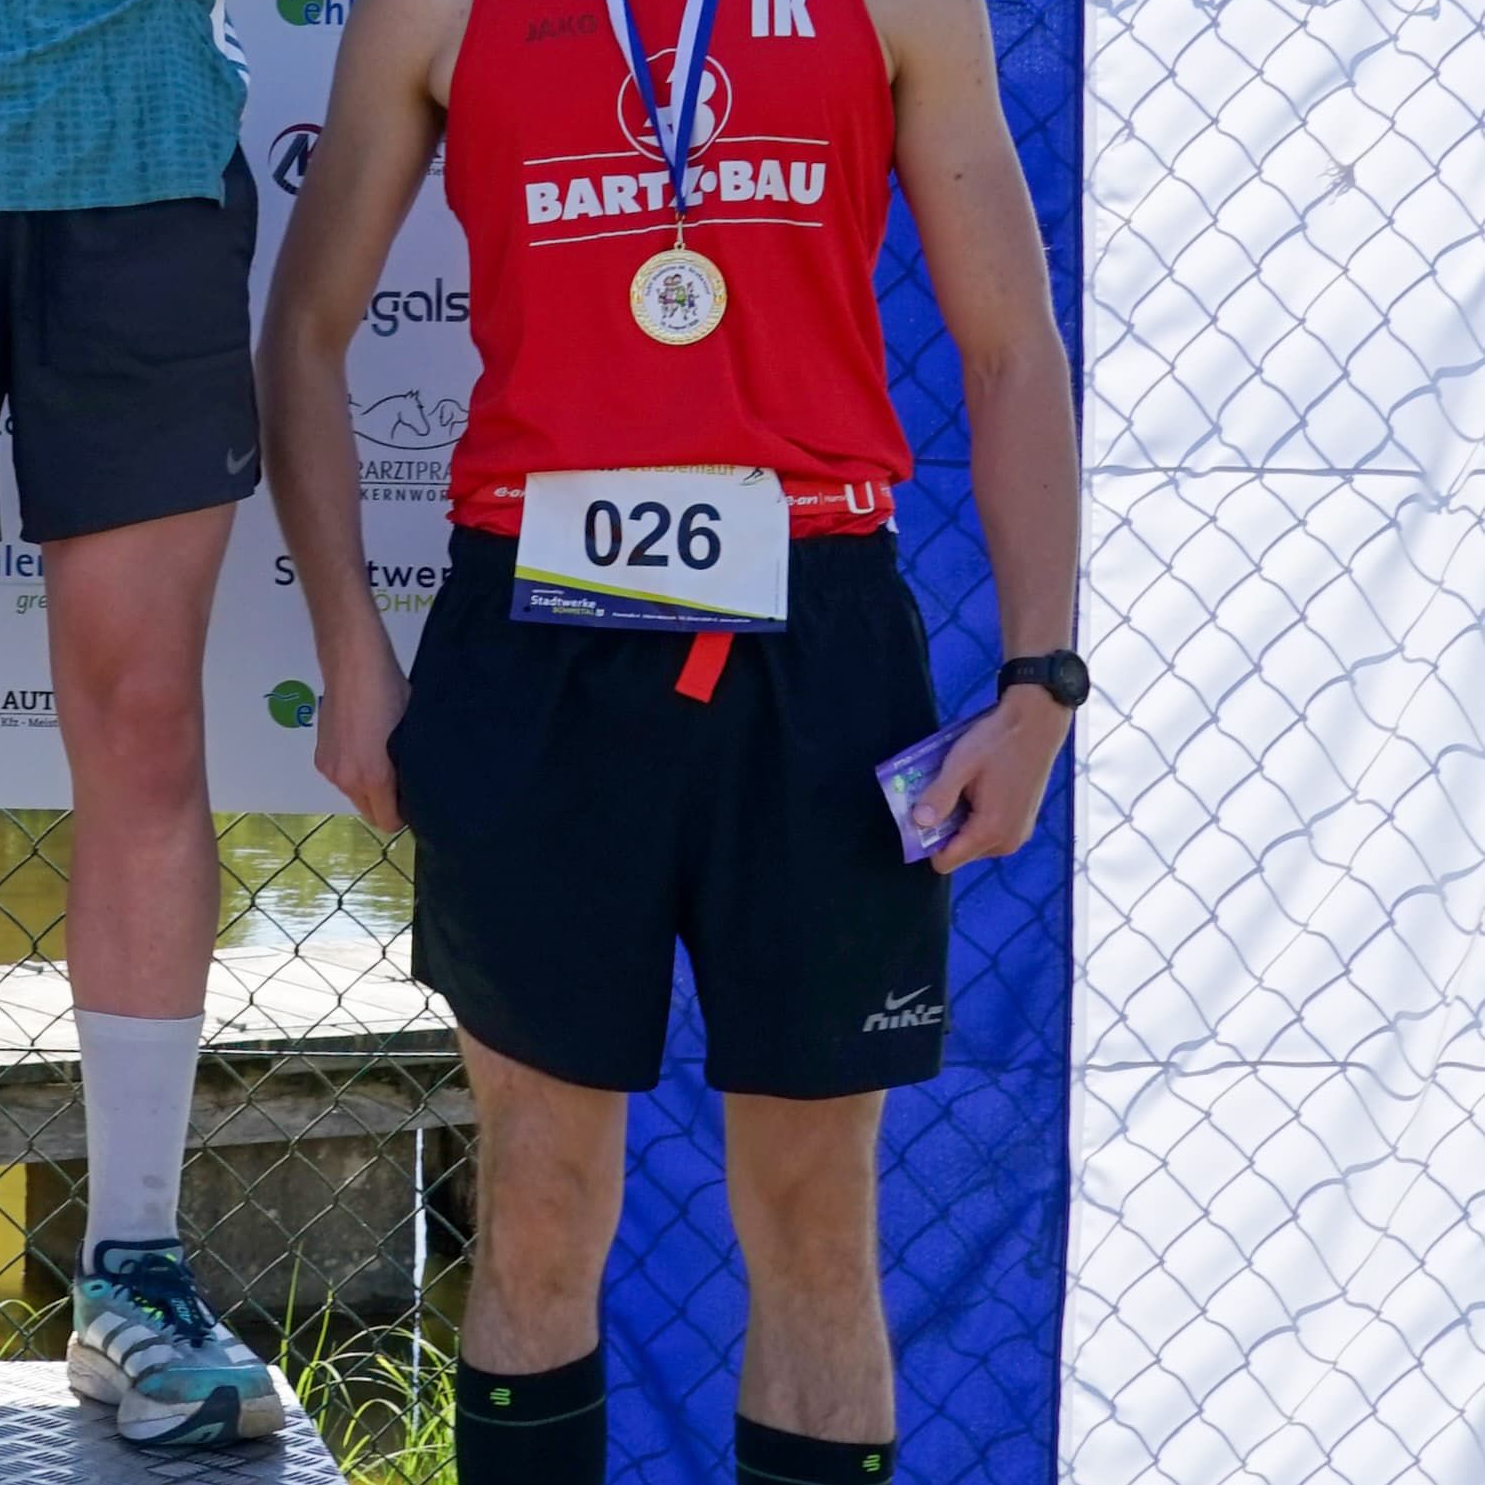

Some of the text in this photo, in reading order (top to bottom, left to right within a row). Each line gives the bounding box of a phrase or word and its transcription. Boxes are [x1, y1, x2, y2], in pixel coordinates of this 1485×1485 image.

[525, 15, 597, 42] JAKO
[584, 500, 722, 570] 026
[530, 595, 597, 610] Stadtwerke
[1, 691, 55, 710] AUT
